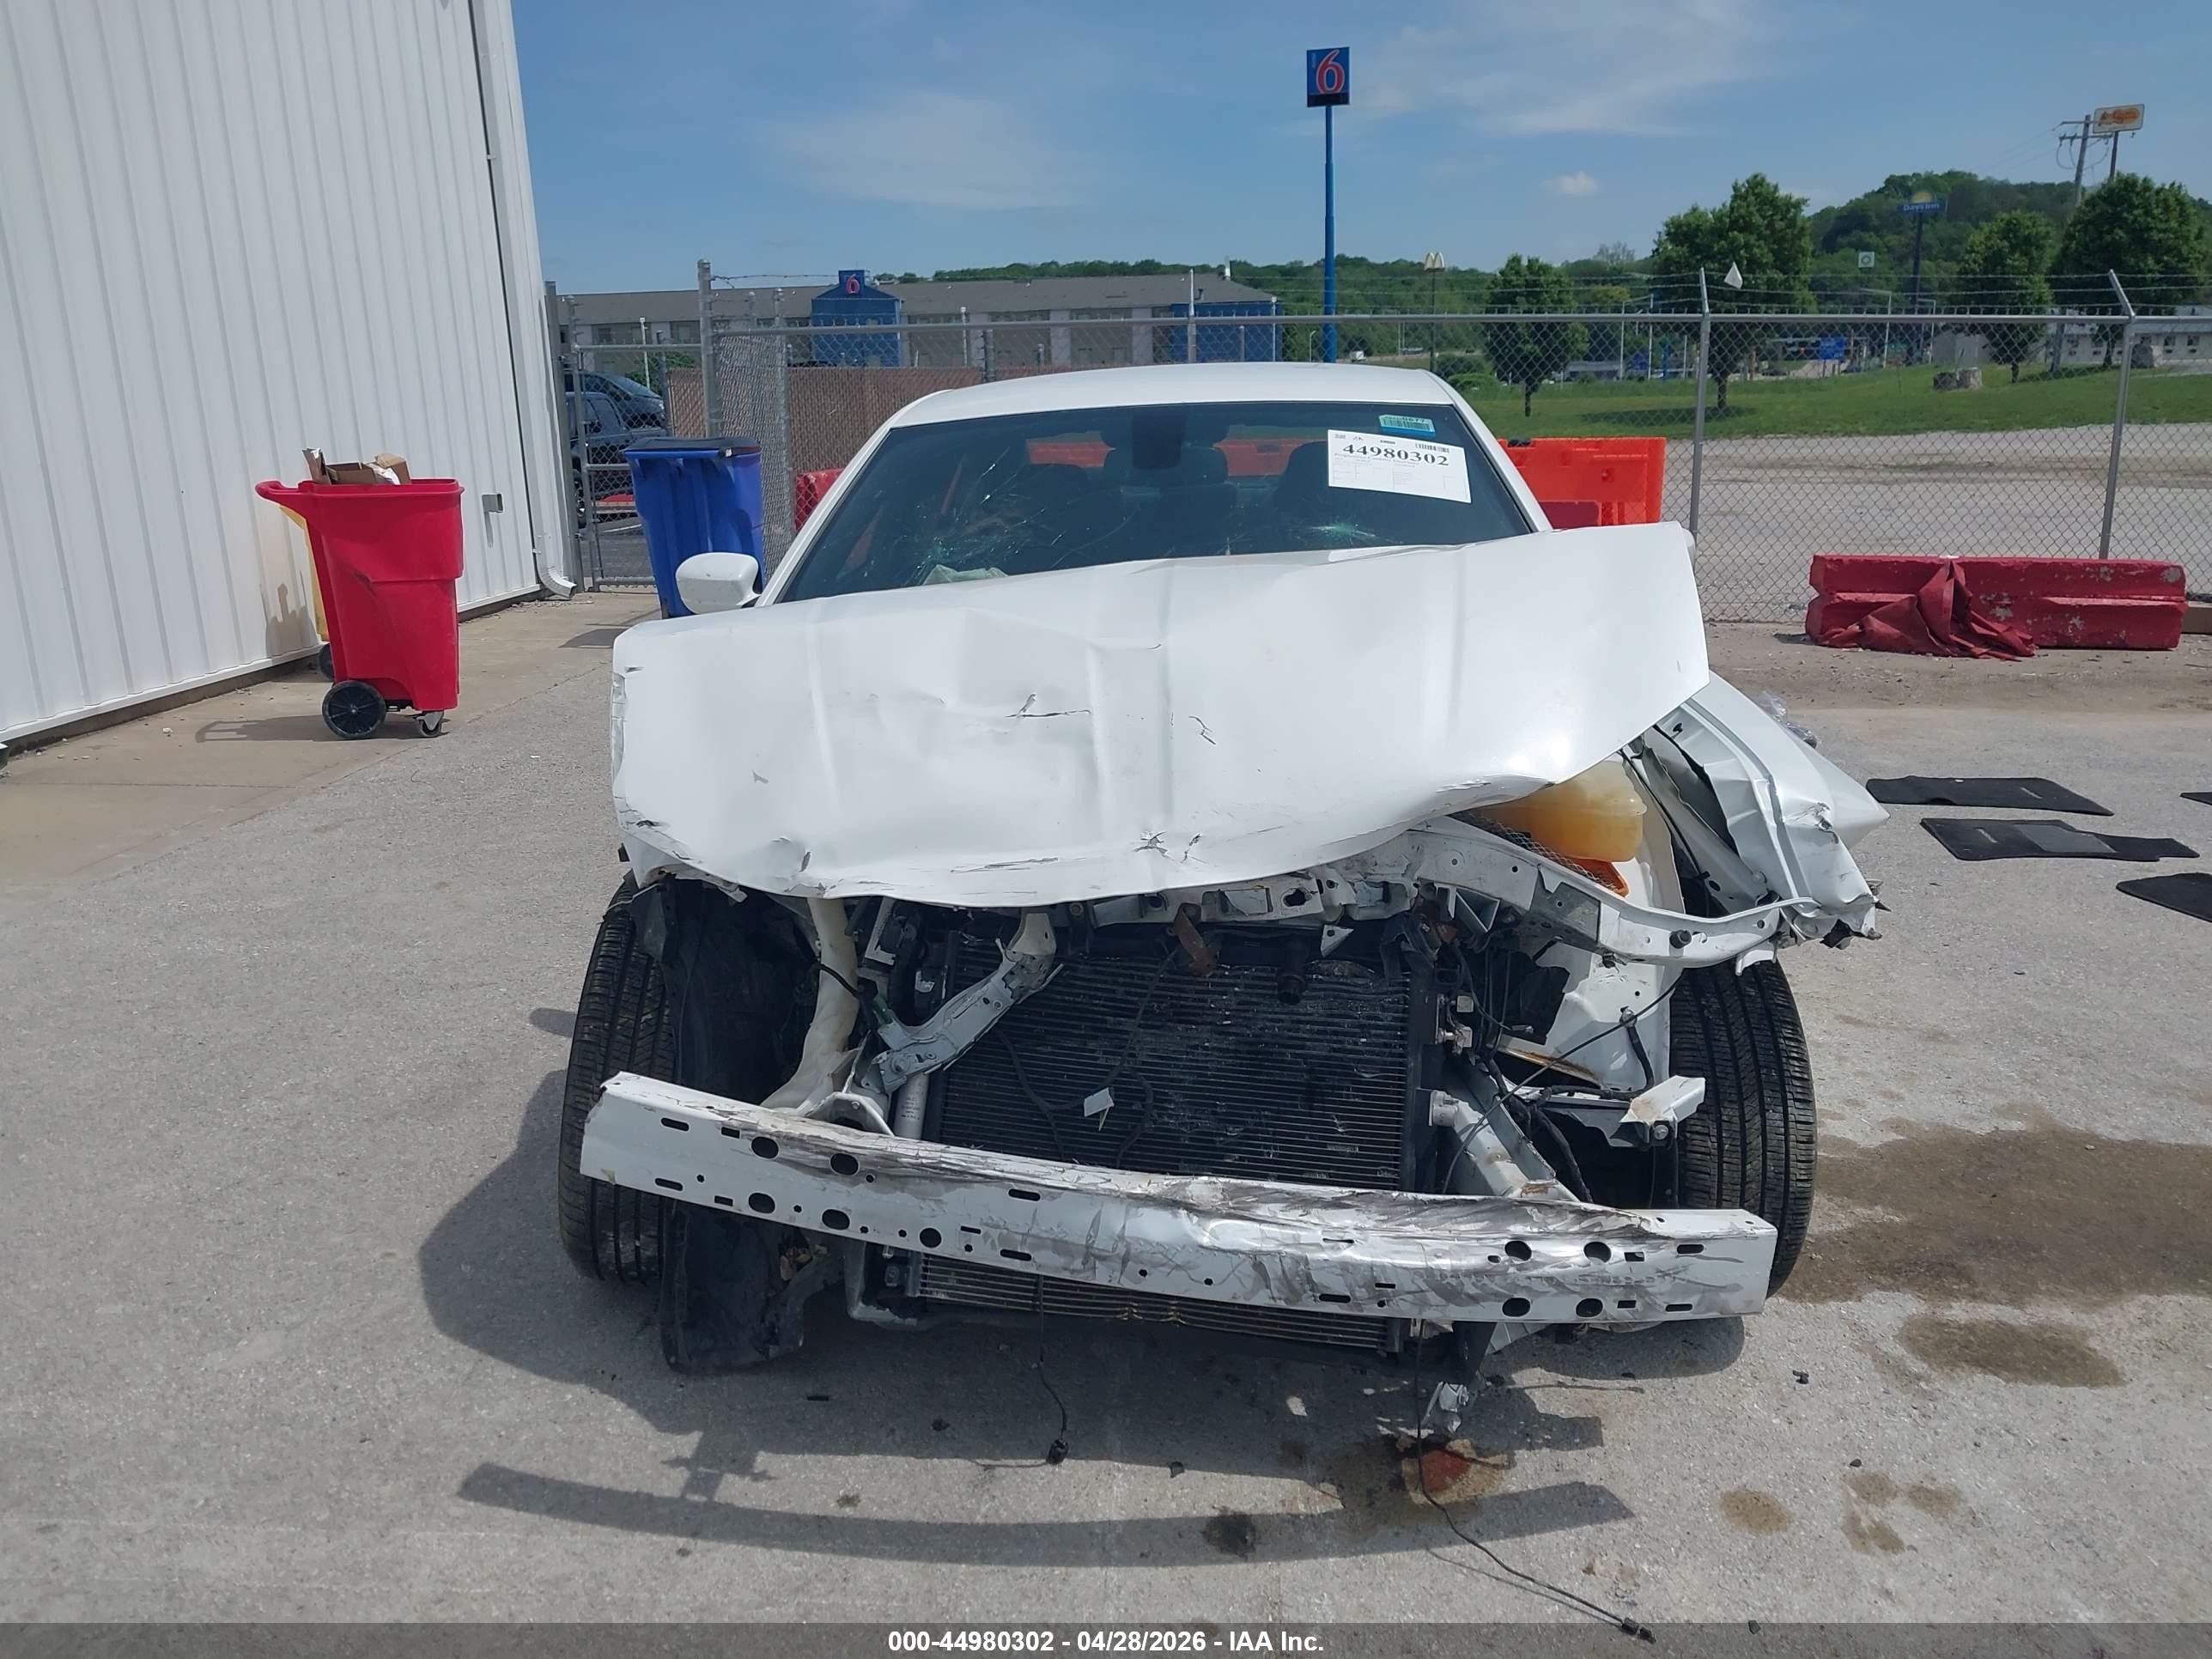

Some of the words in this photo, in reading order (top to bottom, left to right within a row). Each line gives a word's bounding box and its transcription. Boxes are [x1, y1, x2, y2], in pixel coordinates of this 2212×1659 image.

[1316, 49, 1346, 94] 6
[846, 274, 860, 295] 6
[1342, 443, 1449, 467] 44980302
